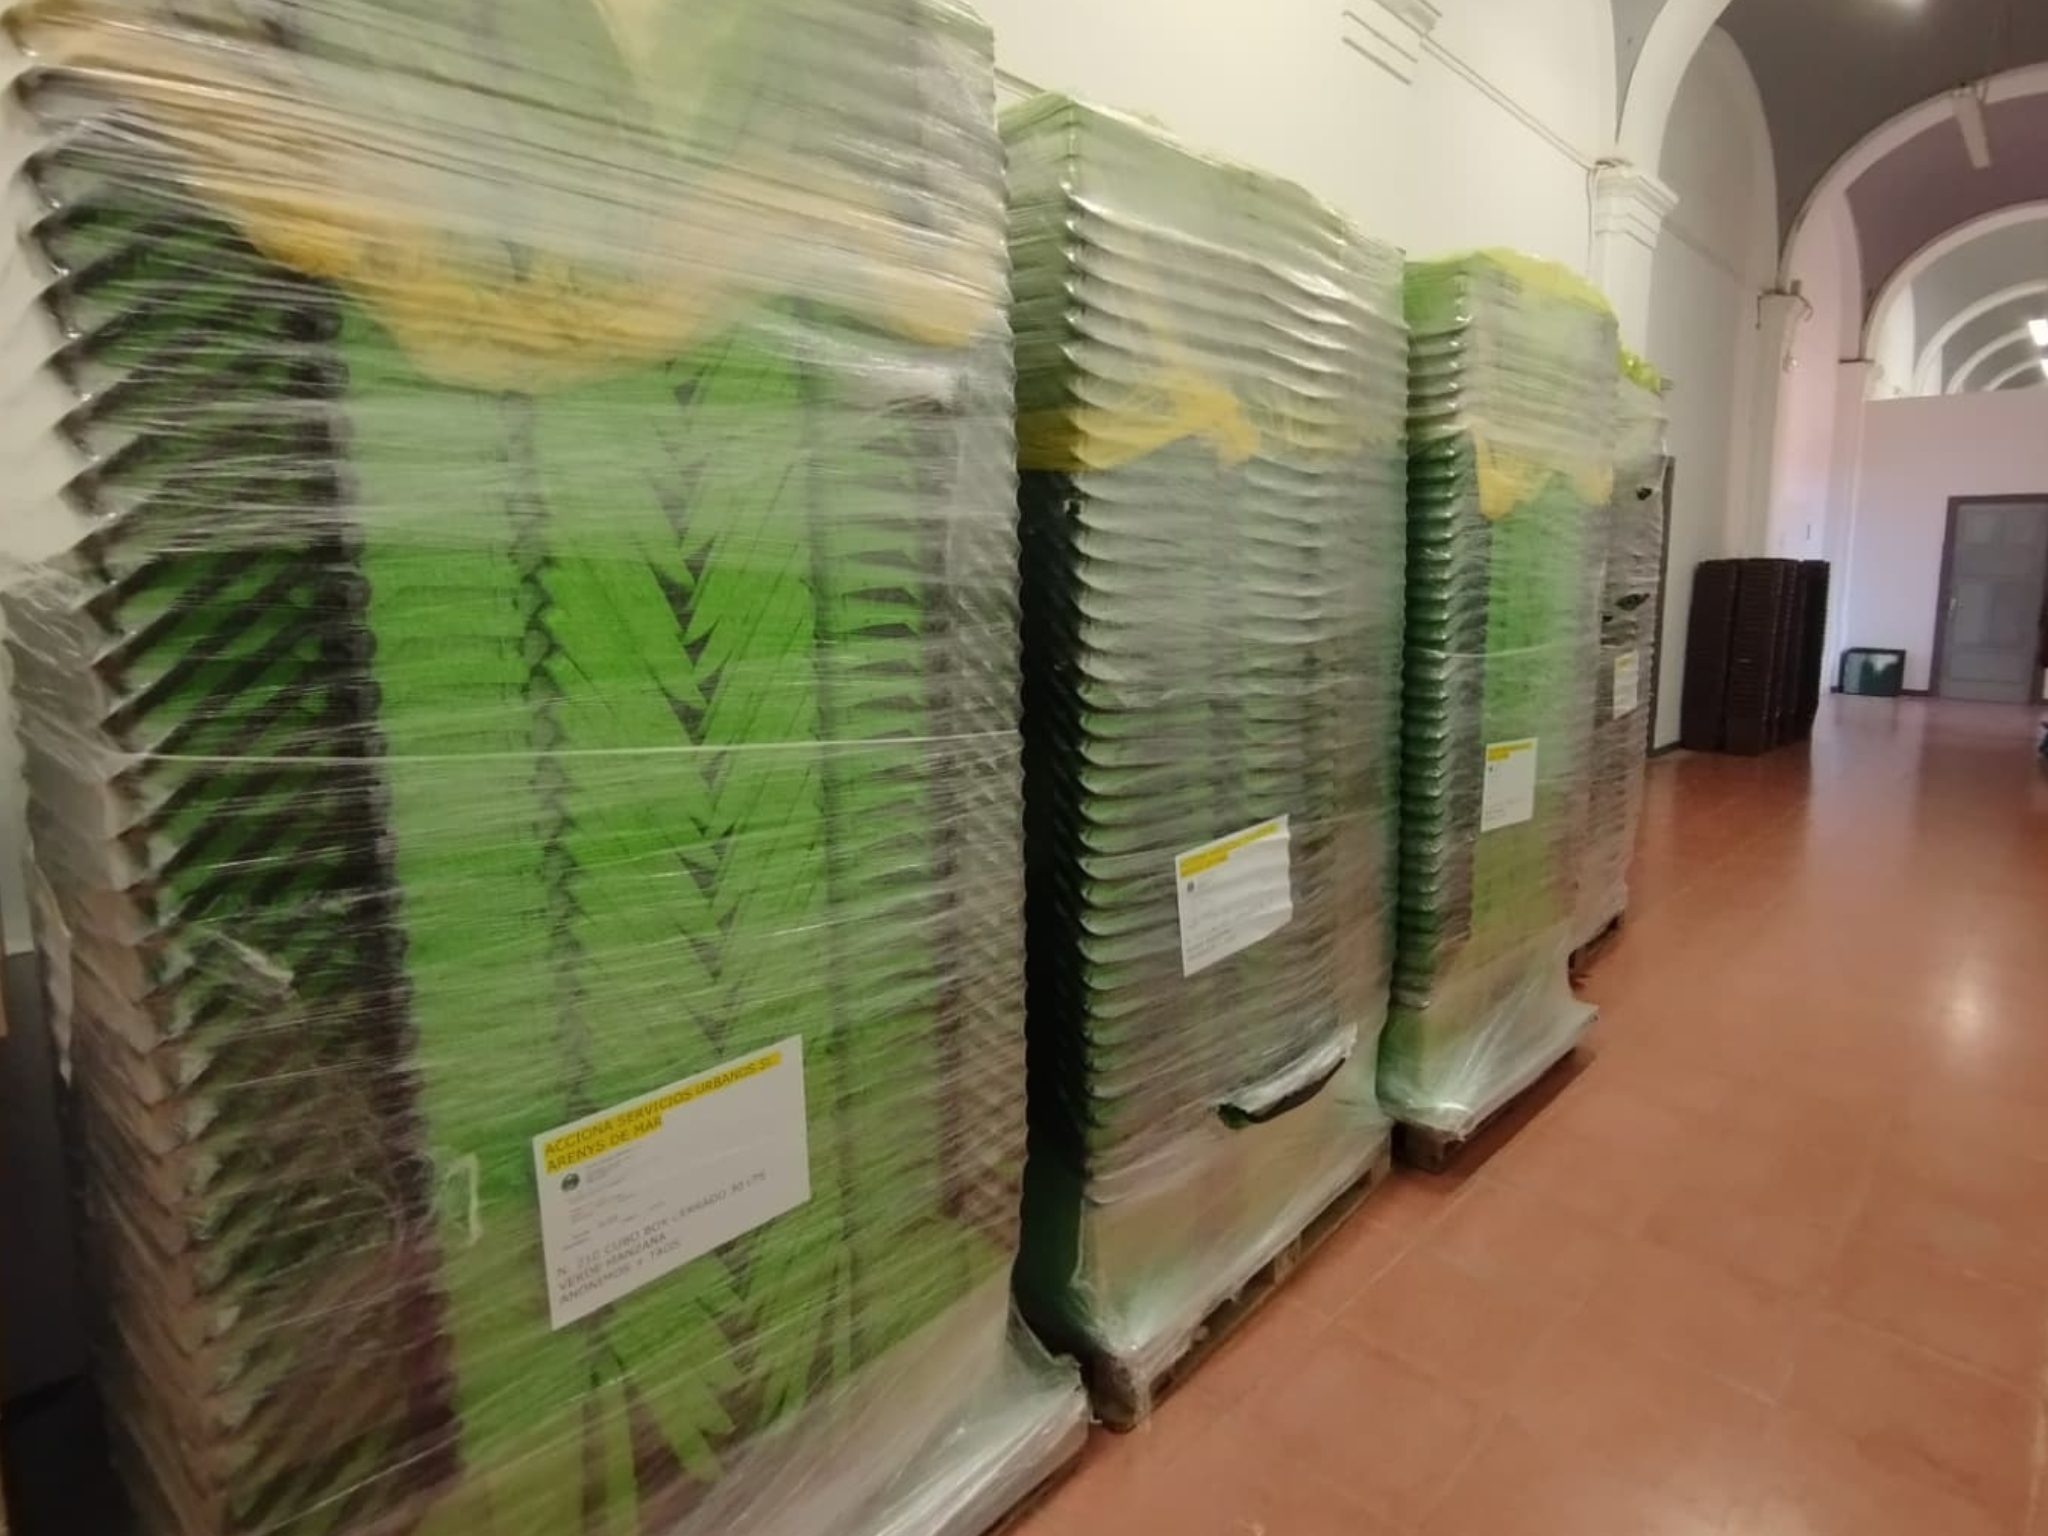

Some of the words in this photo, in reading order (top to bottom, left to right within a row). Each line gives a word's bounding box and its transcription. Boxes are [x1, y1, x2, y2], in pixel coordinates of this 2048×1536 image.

[543, 1119, 612, 1157] ACCIONA
[546, 1137, 606, 1173] ARENYS
[633, 1114, 662, 1137] MAR
